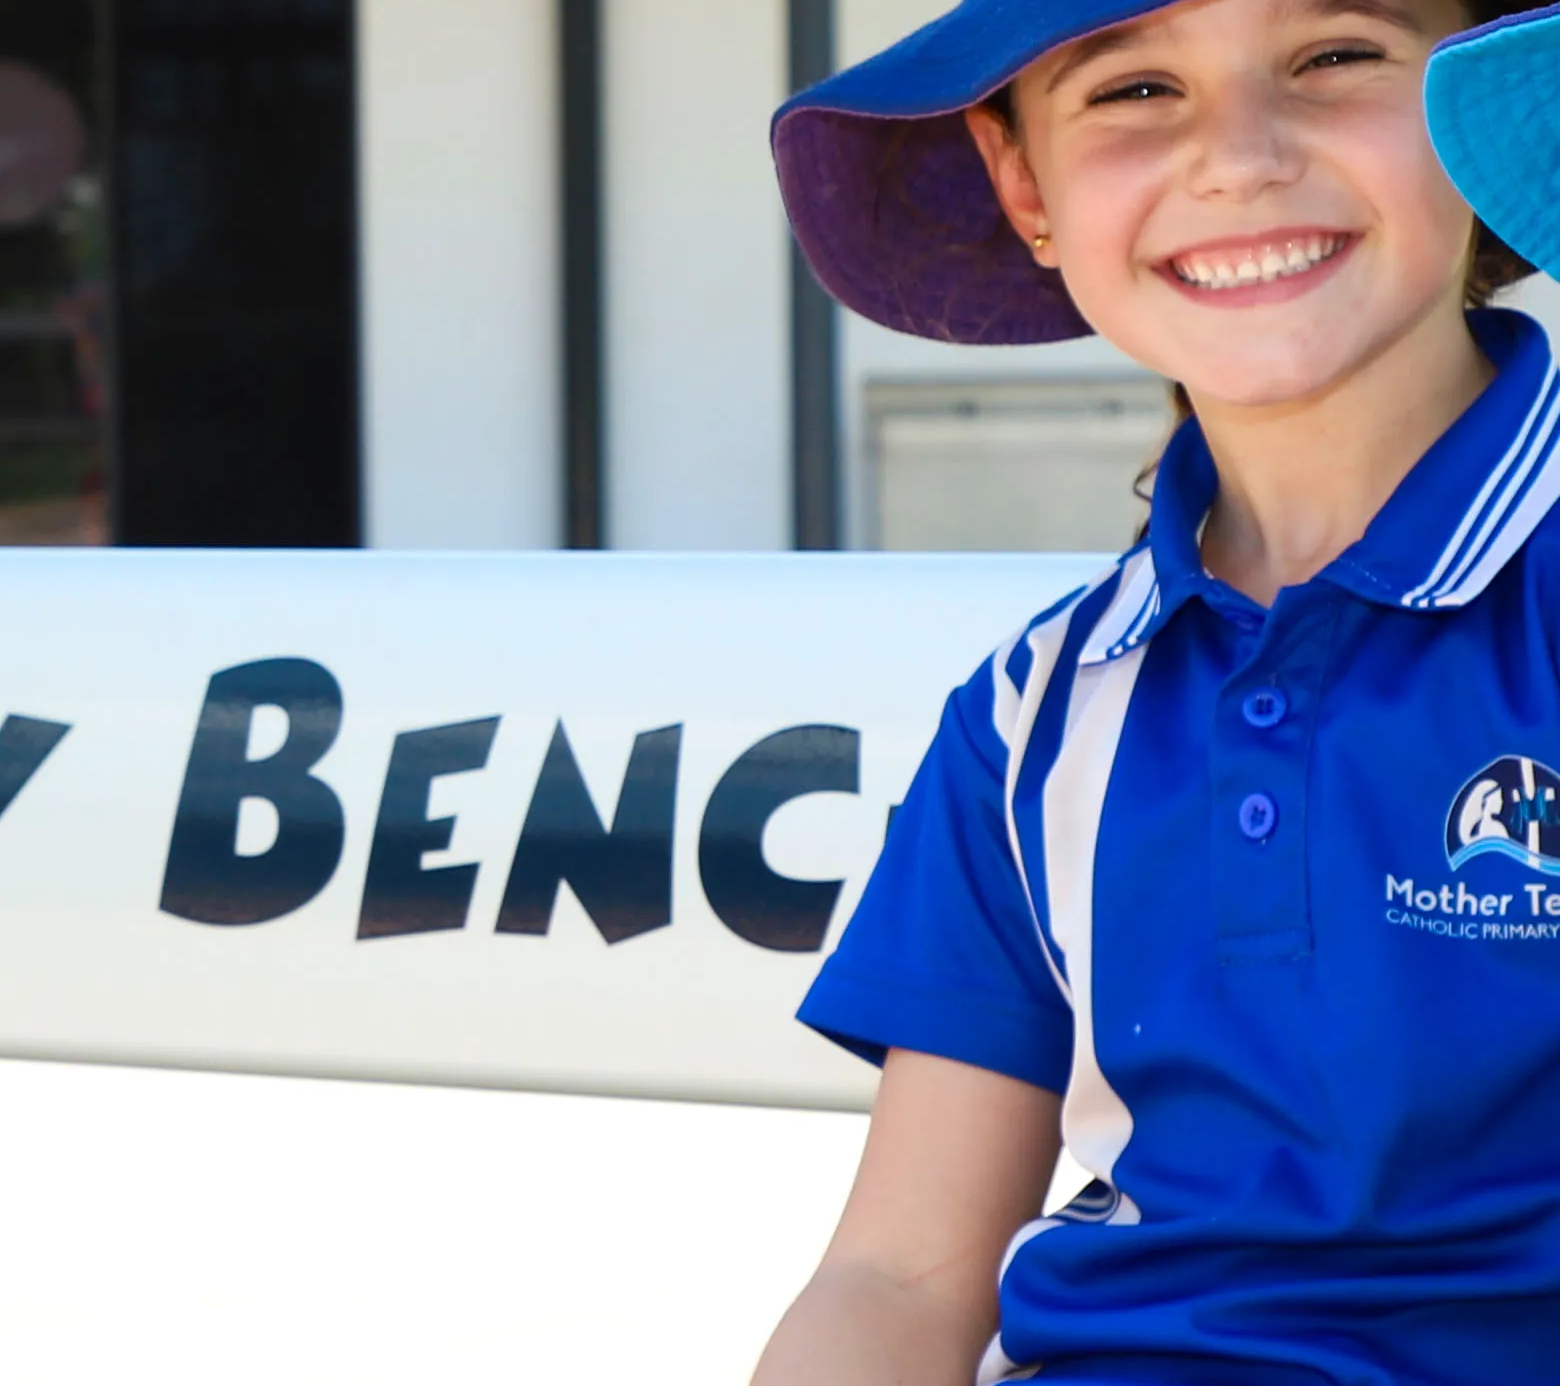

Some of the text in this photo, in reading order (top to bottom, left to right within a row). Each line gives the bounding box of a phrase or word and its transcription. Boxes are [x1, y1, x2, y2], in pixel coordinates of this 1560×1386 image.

[159, 656, 902, 952] BENC
[1385, 873, 1513, 917] Mother
[1386, 909, 1478, 940] CATHOLIC
[1482, 922, 1560, 940] PRIMARY
